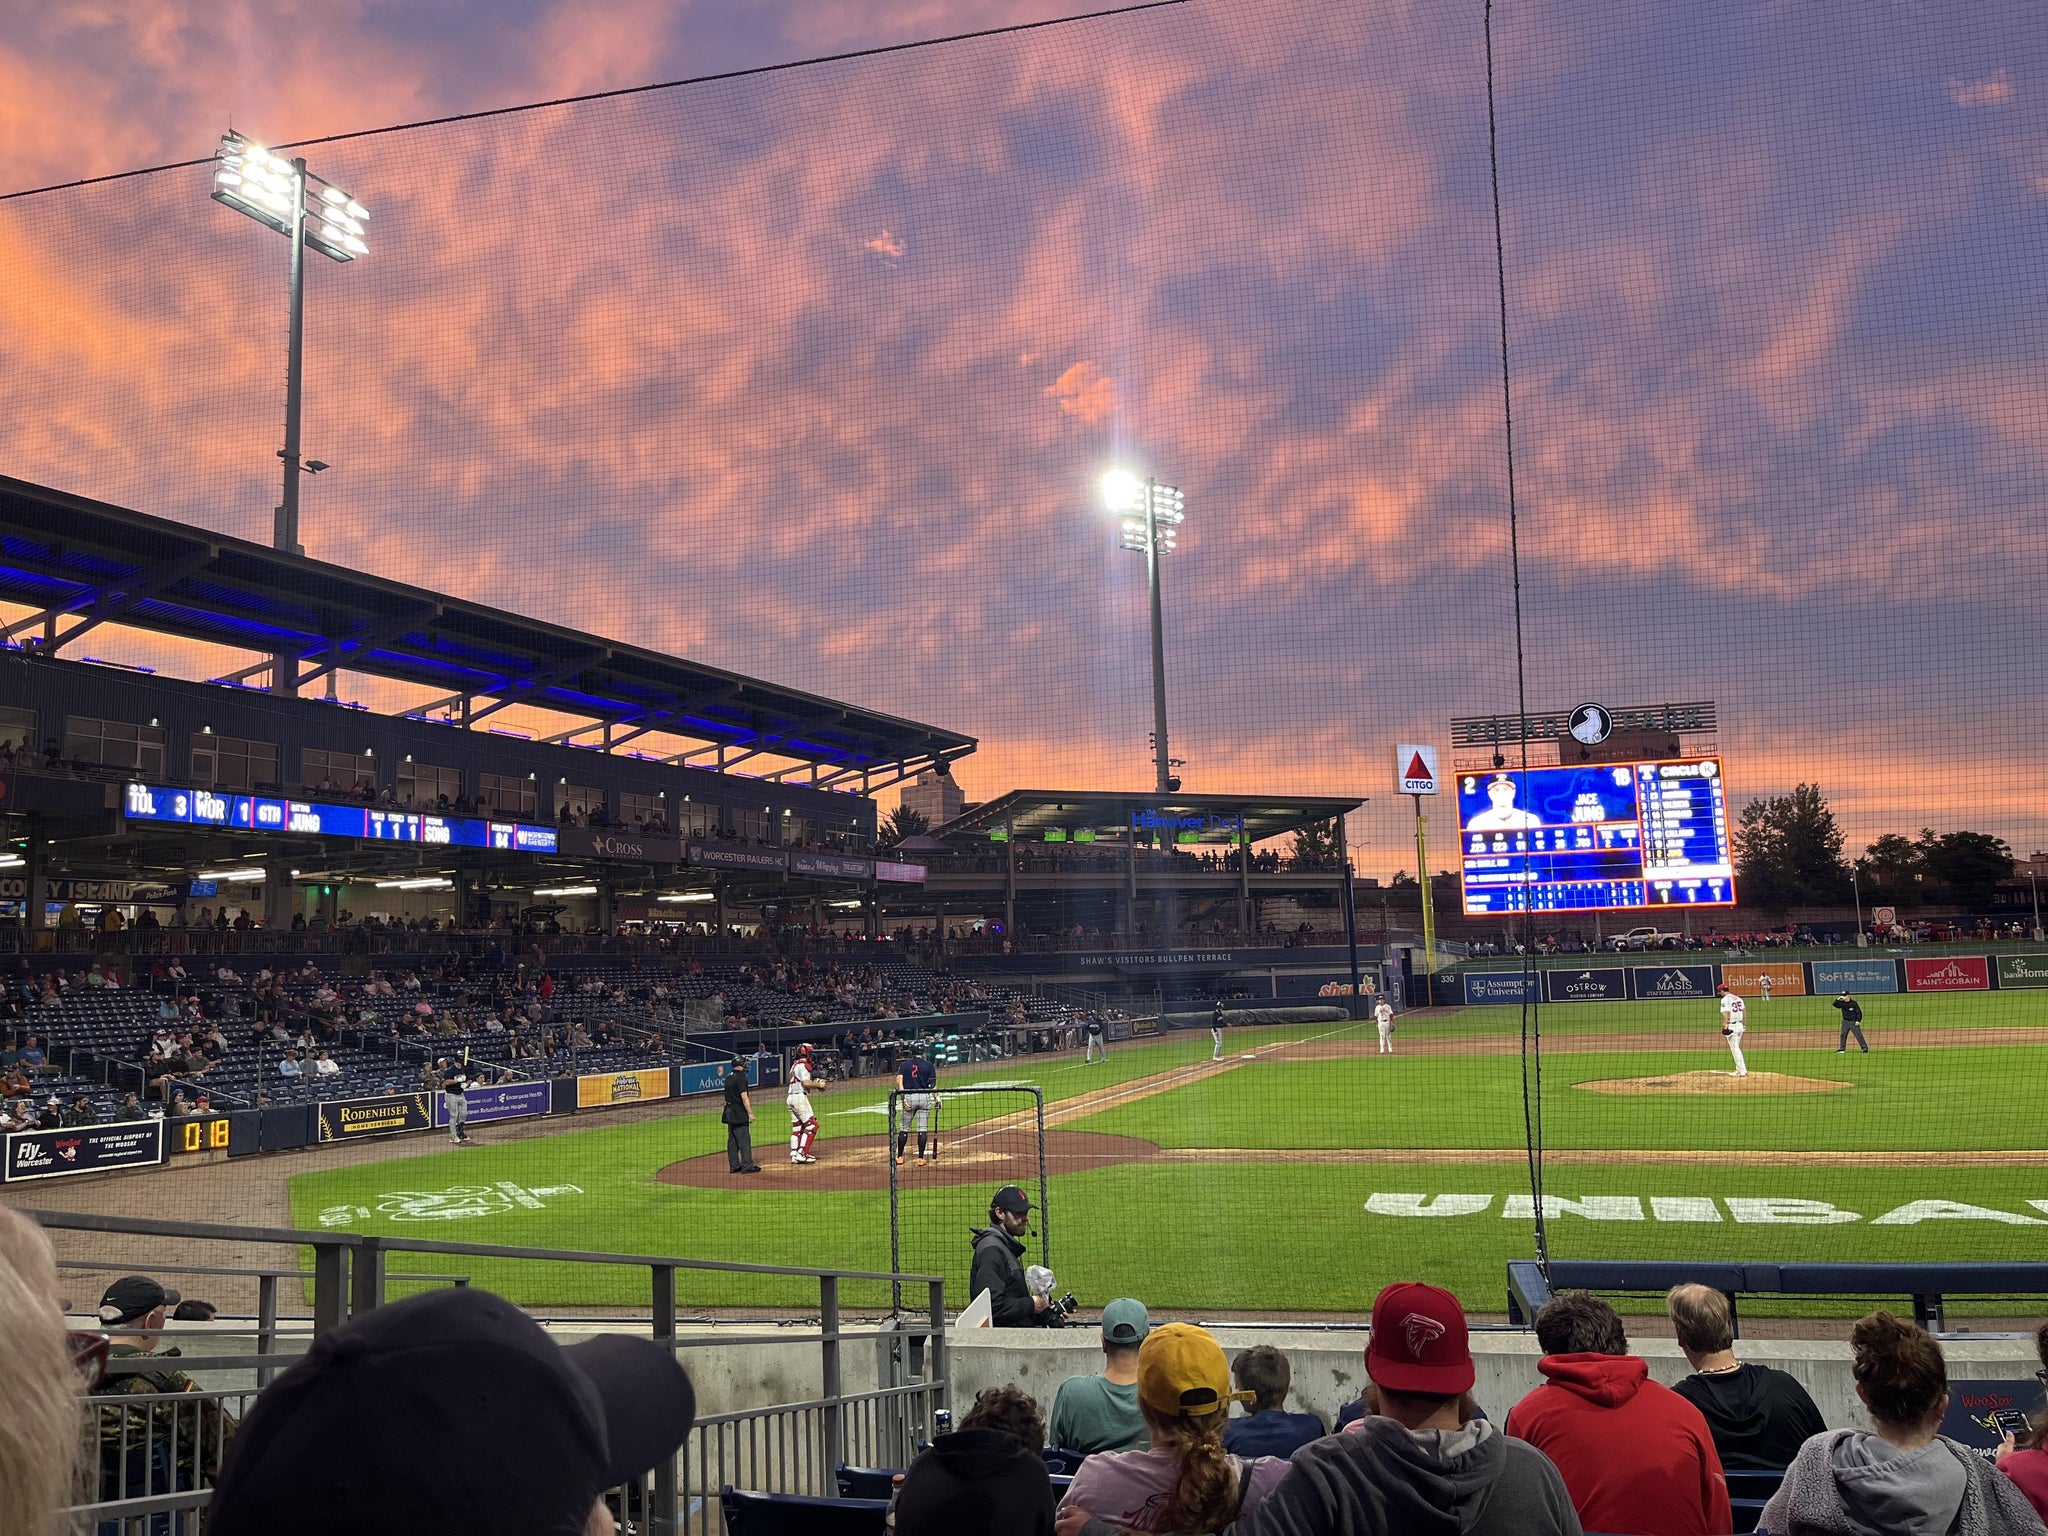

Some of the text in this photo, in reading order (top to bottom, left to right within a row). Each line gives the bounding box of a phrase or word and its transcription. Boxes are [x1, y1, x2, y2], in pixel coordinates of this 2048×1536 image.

[1466, 710, 1703, 741] POLAR PARK
[1660, 765, 1699, 777] CIRCLE
[1406, 781, 1433, 789] CITGO
[1464, 776, 1476, 794] 2
[130, 792, 186, 816] TOL 3
[1576, 793, 1598, 806] JACE
[196, 798, 248, 822] WOR 1
[258, 805, 281, 822] 6TH
[1572, 805, 1606, 822] JUNG
[289, 814, 320, 832] JUNG
[1132, 812, 1206, 829] Hanover
[374, 822, 417, 840] 1 1 1
[425, 826, 450, 844] SONG
[703, 851, 784, 866] WORCESTER RAILERS HC
[0, 879, 63, 898] COY
[68, 882, 134, 900] ISLAND
[1661, 888, 1719, 902] 1 1 1
[1080, 954, 1232, 965] SHAW'S VISITORS BULLPEN TERRACE
[1441, 975, 1455, 983] 330
[1487, 980, 1534, 988] Assumpton
[1728, 974, 1800, 986] fallonealth
[1819, 972, 1843, 982] SoFi
[1916, 977, 1980, 986] SAINT-GOBAIN
[1487, 988, 1528, 996] Universit
[1566, 983, 1607, 992] OSTROW
[1656, 981, 1692, 990] MASIS
[912, 1064, 919, 1078] 2
[613, 1082, 640, 1093] NATIONAL
[617, 1076, 637, 1085] Hebrew
[340, 1106, 408, 1122] RODENHISER
[184, 1120, 229, 1150] 0:18
[17, 1142, 40, 1160] Fly
[17, 1158, 53, 1168] Worcester
[1364, 1193, 2048, 1224] UNIBA
[1961, 1392, 2013, 1408] WooSox
